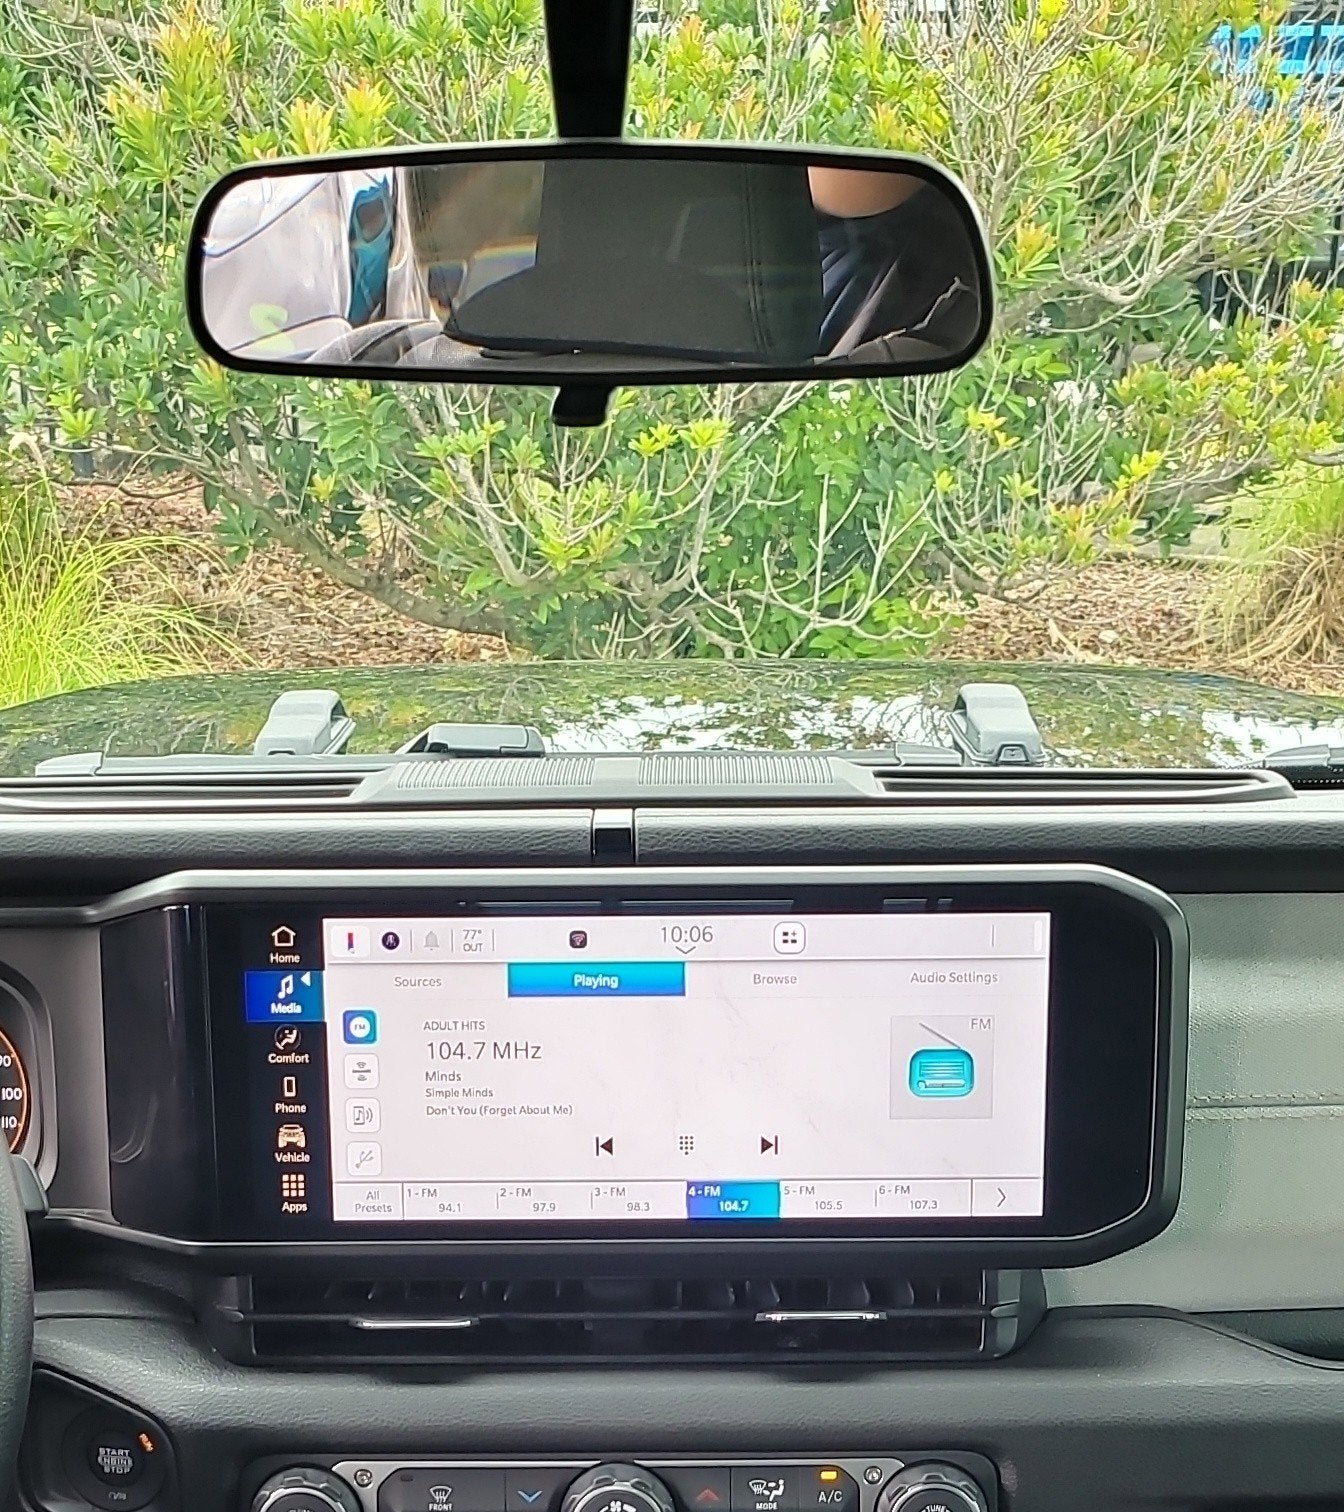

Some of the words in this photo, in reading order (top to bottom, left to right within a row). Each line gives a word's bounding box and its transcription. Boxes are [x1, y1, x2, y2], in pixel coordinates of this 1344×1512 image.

[660, 926, 714, 944] 10:06
[462, 943, 484, 953] OUT
[270, 953, 301, 964] Home
[394, 976, 443, 988] Sources
[573, 974, 619, 989] Playing
[752, 972, 798, 986] Browse
[910, 971, 946, 985] Audio
[948, 971, 999, 985] Settings
[270, 1003, 302, 1014] Media
[423, 1021, 459, 1031] ADULT
[461, 1021, 486, 1031] HITS
[970, 1018, 992, 1030] FM
[427, 1041, 486, 1060] 104.7
[493, 1041, 543, 1060] MHz
[268, 1053, 310, 1065] Comfort
[425, 1070, 462, 1082] Minds
[1, 1087, 23, 1100] 100
[425, 1088, 460, 1099] Simple
[462, 1087, 494, 1097] Minds
[275, 1103, 307, 1113] Phone
[426, 1105, 455, 1116] Don't
[458, 1105, 477, 1115] You
[479, 1105, 517, 1117] (Forget
[519, 1105, 550, 1115] About
[553, 1105, 574, 1116] Me)
[1, 1117, 17, 1129] 110
[274, 1152, 311, 1163] Vehicle
[366, 1190, 380, 1200] All
[422, 1188, 438, 1197] FM
[516, 1188, 532, 1197] FM
[610, 1188, 626, 1197] FM
[704, 1186, 720, 1197] FM
[799, 1186, 815, 1196] FM
[895, 1185, 911, 1195] FM
[281, 1202, 308, 1214] Apps
[355, 1203, 393, 1214] Presets
[438, 1203, 462, 1213] 94.1
[532, 1203, 556, 1213] 97.9
[626, 1202, 651, 1212] 98.3
[718, 1201, 749, 1213] 104.7
[814, 1201, 843, 1211] 105.5
[909, 1200, 938, 1210] 107.3
[98, 1447, 131, 1456] START
[818, 1490, 843, 1503] A/C
[428, 1503, 453, 1512] FRONT
[756, 1502, 778, 1511] MODE
[926, 1504, 946, 1512] TUNE
